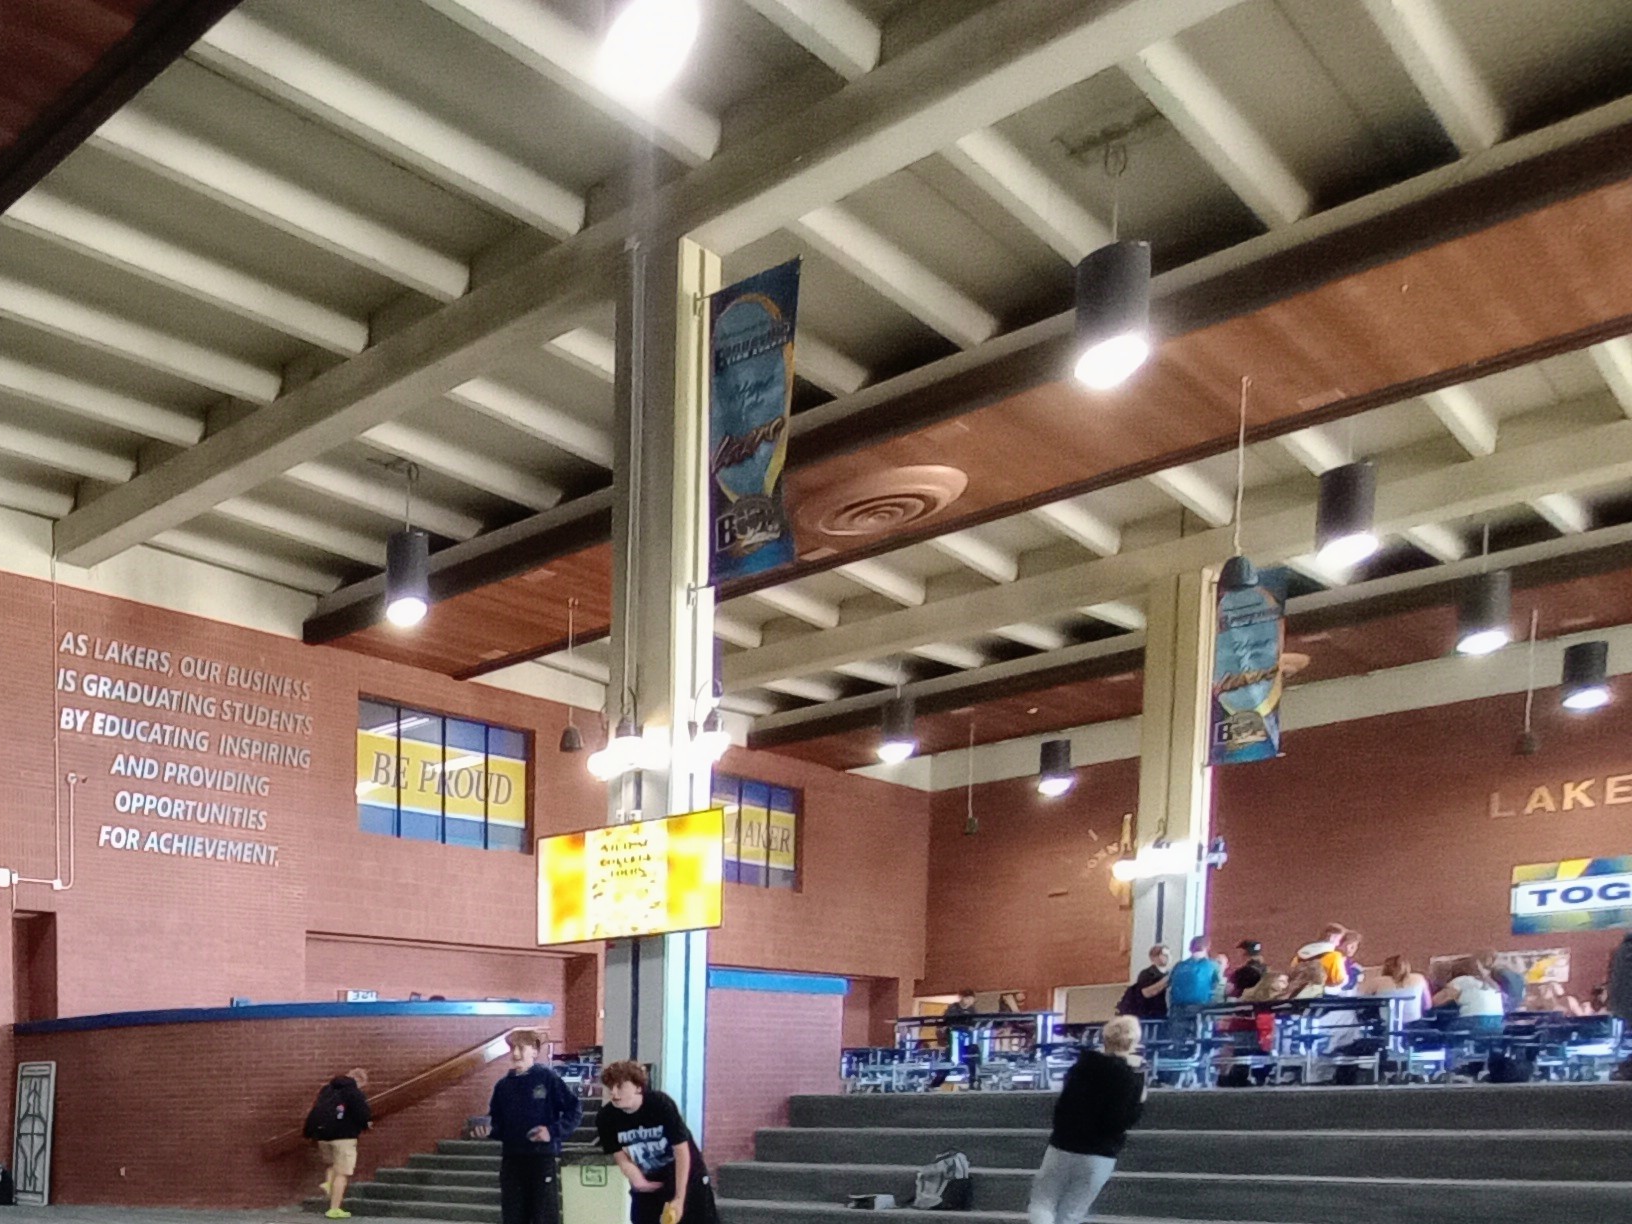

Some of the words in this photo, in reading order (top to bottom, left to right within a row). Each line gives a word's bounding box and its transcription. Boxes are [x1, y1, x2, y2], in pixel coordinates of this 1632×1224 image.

[59, 631, 89, 656] AS
[94, 637, 174, 678] LAKERS,
[179, 656, 222, 683] OUR
[226, 666, 311, 700] BUSINESS
[56, 668, 77, 692] IS
[82, 673, 216, 718] GRADUATING
[220, 699, 314, 735] STUDENTS
[60, 707, 90, 732] BY
[91, 712, 210, 752] EDUCATING
[218, 734, 312, 769] INSPIRING
[110, 754, 159, 780] AND
[163, 761, 271, 797] PROVIDING
[371, 751, 410, 790] BE
[418, 760, 512, 805] PROUD
[1489, 773, 1632, 819] LAKE
[114, 790, 268, 830] OPPORTUNITIES
[98, 825, 140, 850] FOR
[143, 831, 280, 867] ACHIEVEMENT.
[1528, 882, 1632, 907] TOG
